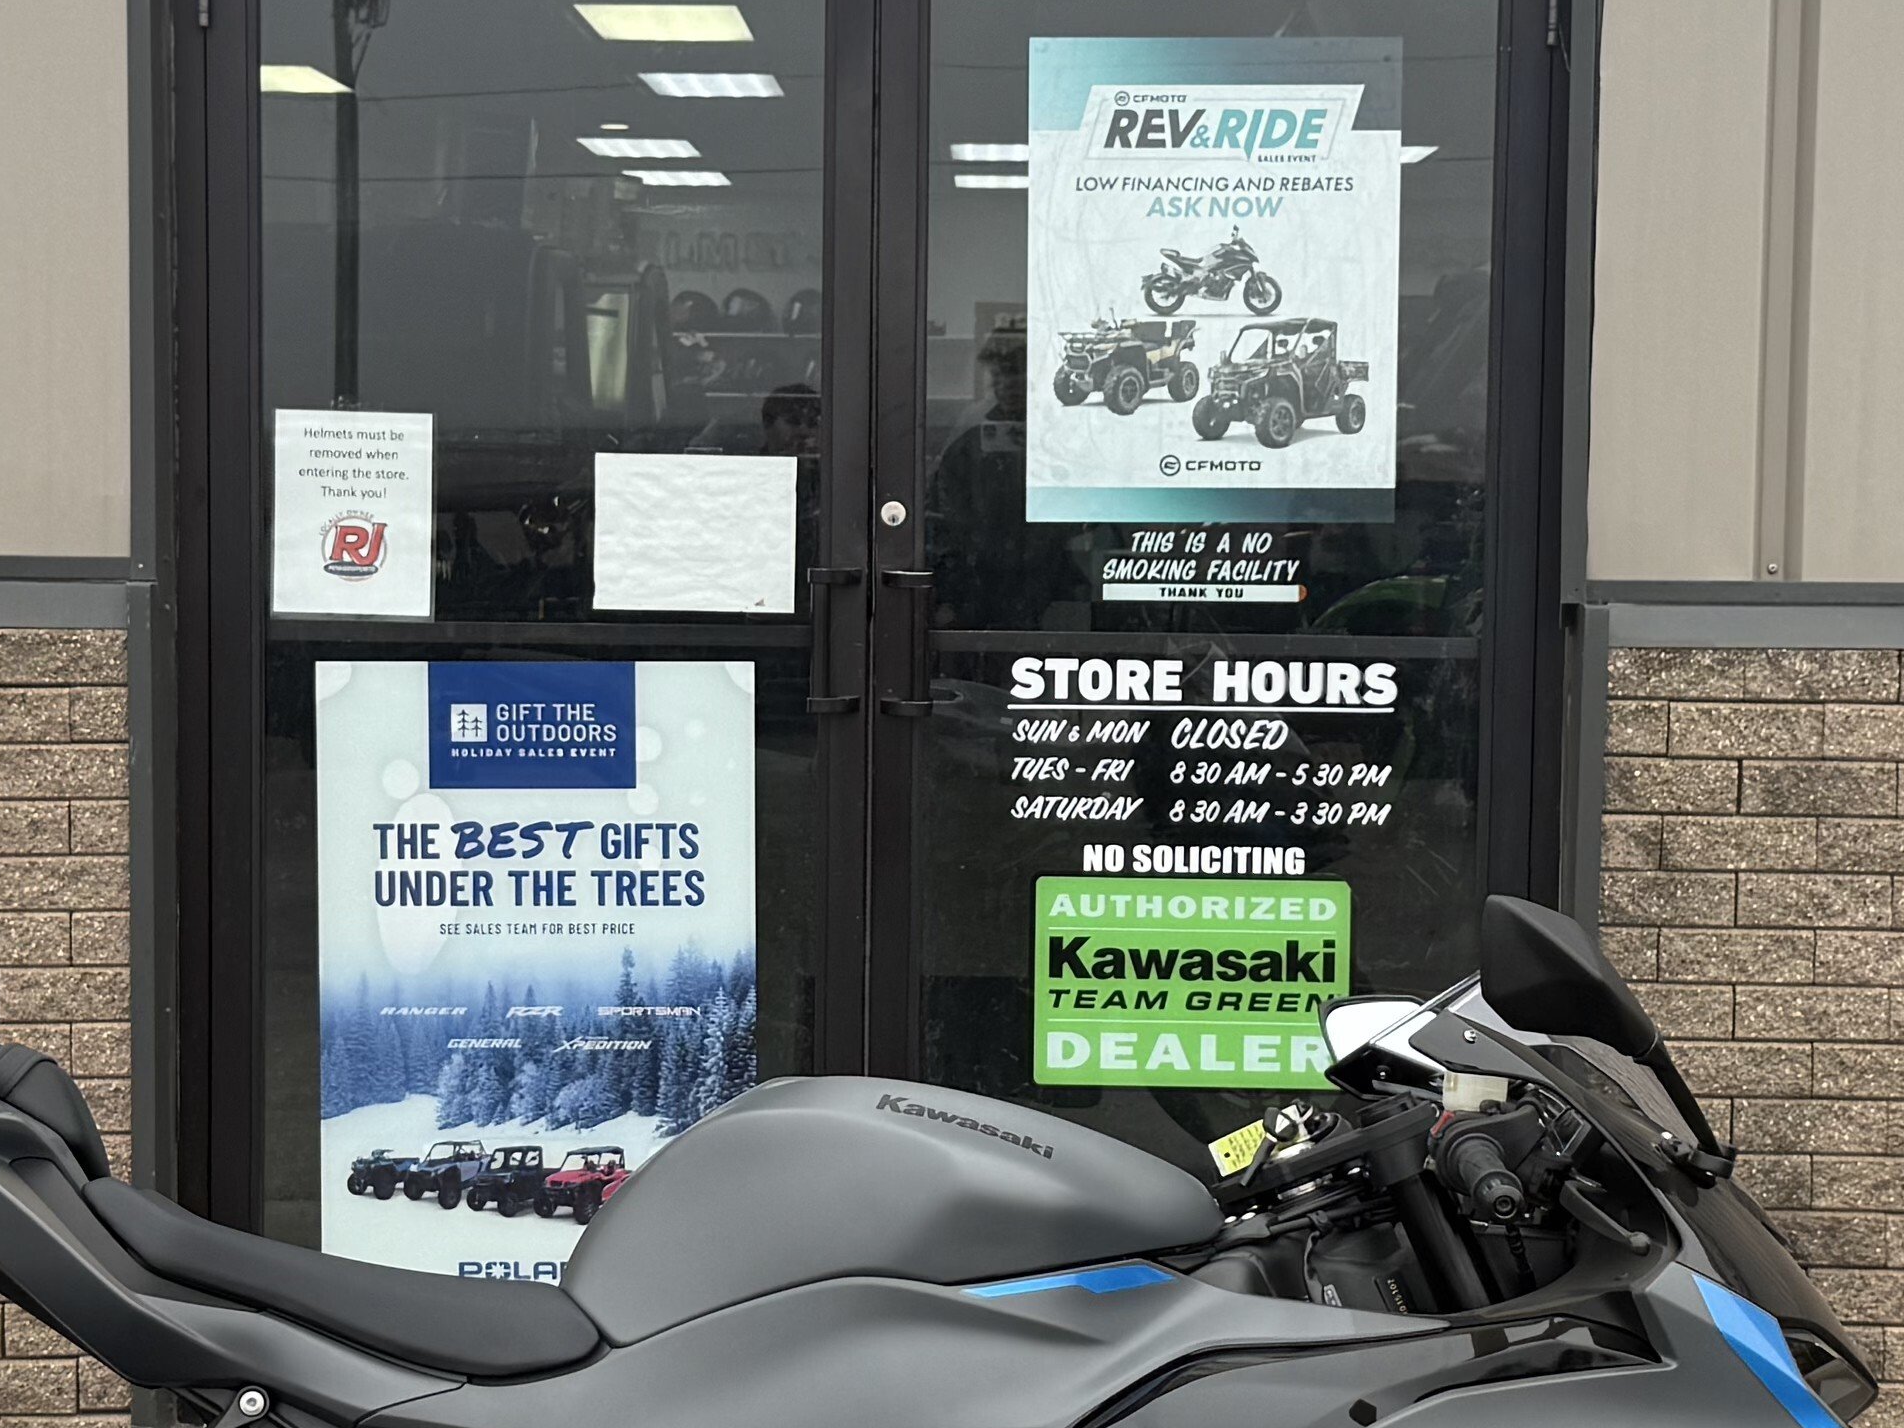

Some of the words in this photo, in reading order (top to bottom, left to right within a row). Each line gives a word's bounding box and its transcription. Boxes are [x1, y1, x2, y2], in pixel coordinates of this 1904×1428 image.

[1075, 176, 1120, 192] LOW
[1122, 176, 1228, 192] FINANCING
[1230, 176, 1276, 192] AND
[1279, 176, 1354, 192] REBATES
[1145, 196, 1203, 218] ASK
[1208, 196, 1285, 218] NOW
[304, 427, 353, 440] Helmets
[356, 430, 387, 440] must
[390, 429, 405, 441] be
[309, 448, 362, 459] removed
[366, 449, 399, 460] when
[298, 468, 349, 480] entering
[352, 468, 372, 479] the
[375, 470, 410, 481] store.
[1185, 460, 1263, 472] CFMOTO
[321, 486, 357, 498] Thank
[361, 487, 388, 500] you!
[329, 521, 388, 567] RJ
[1131, 531, 1175, 553] THIS
[1184, 531, 1208, 553] IS
[1216, 532, 1231, 554] A
[1241, 532, 1273, 554] NO
[1102, 558, 1197, 581] SMOKING
[1206, 559, 1300, 582] FACILITY
[1158, 586, 1208, 598] THANK
[1215, 586, 1245, 598] YOU
[1010, 657, 1183, 702] STORE
[1213, 660, 1398, 706] HOURS
[496, 704, 546, 721] GIFT
[551, 704, 596, 721] THE
[496, 724, 618, 742] OUTDOORS
[1012, 718, 1069, 743] SUN
[1085, 719, 1151, 745] MON
[1170, 717, 1290, 750] CLOSED
[451, 747, 513, 758] HOLIDAY
[518, 747, 565, 758] SALES
[569, 747, 617, 758] EVENT
[1010, 756, 1070, 781] TUES
[1091, 758, 1135, 782] FRI
[1224, 760, 1272, 786] AM
[1347, 763, 1393, 787] PM
[1010, 795, 1145, 822] SATURDAY
[1224, 798, 1271, 824] AM
[1346, 801, 1394, 826] PM
[372, 822, 440, 859] THE
[451, 820, 597, 860] BEST
[600, 822, 700, 859] GIFTS
[1082, 844, 1125, 873] NO
[1132, 844, 1307, 876] SOLICITING
[373, 870, 495, 907] UNDER
[507, 870, 578, 907] THE
[591, 870, 707, 907] TREES
[1048, 893, 1338, 922] AUTHORIZED
[439, 923, 462, 936] SEE
[465, 923, 503, 936] SALES
[505, 923, 538, 936] TEAM
[541, 923, 564, 936] FOR
[568, 923, 598, 936] BEST
[602, 923, 637, 936] PRICE
[1048, 935, 1337, 984] Kawasaki
[1048, 988, 1169, 1011] TEAM
[380, 1005, 469, 1016] RANGER
[597, 1005, 702, 1017] SPORTSMAN
[447, 1037, 523, 1049] GENERAL
[1046, 1030, 1333, 1073] DEALER
[875, 1093, 1055, 1160] Kawasaki
[458, 1261, 568, 1280] POLA
